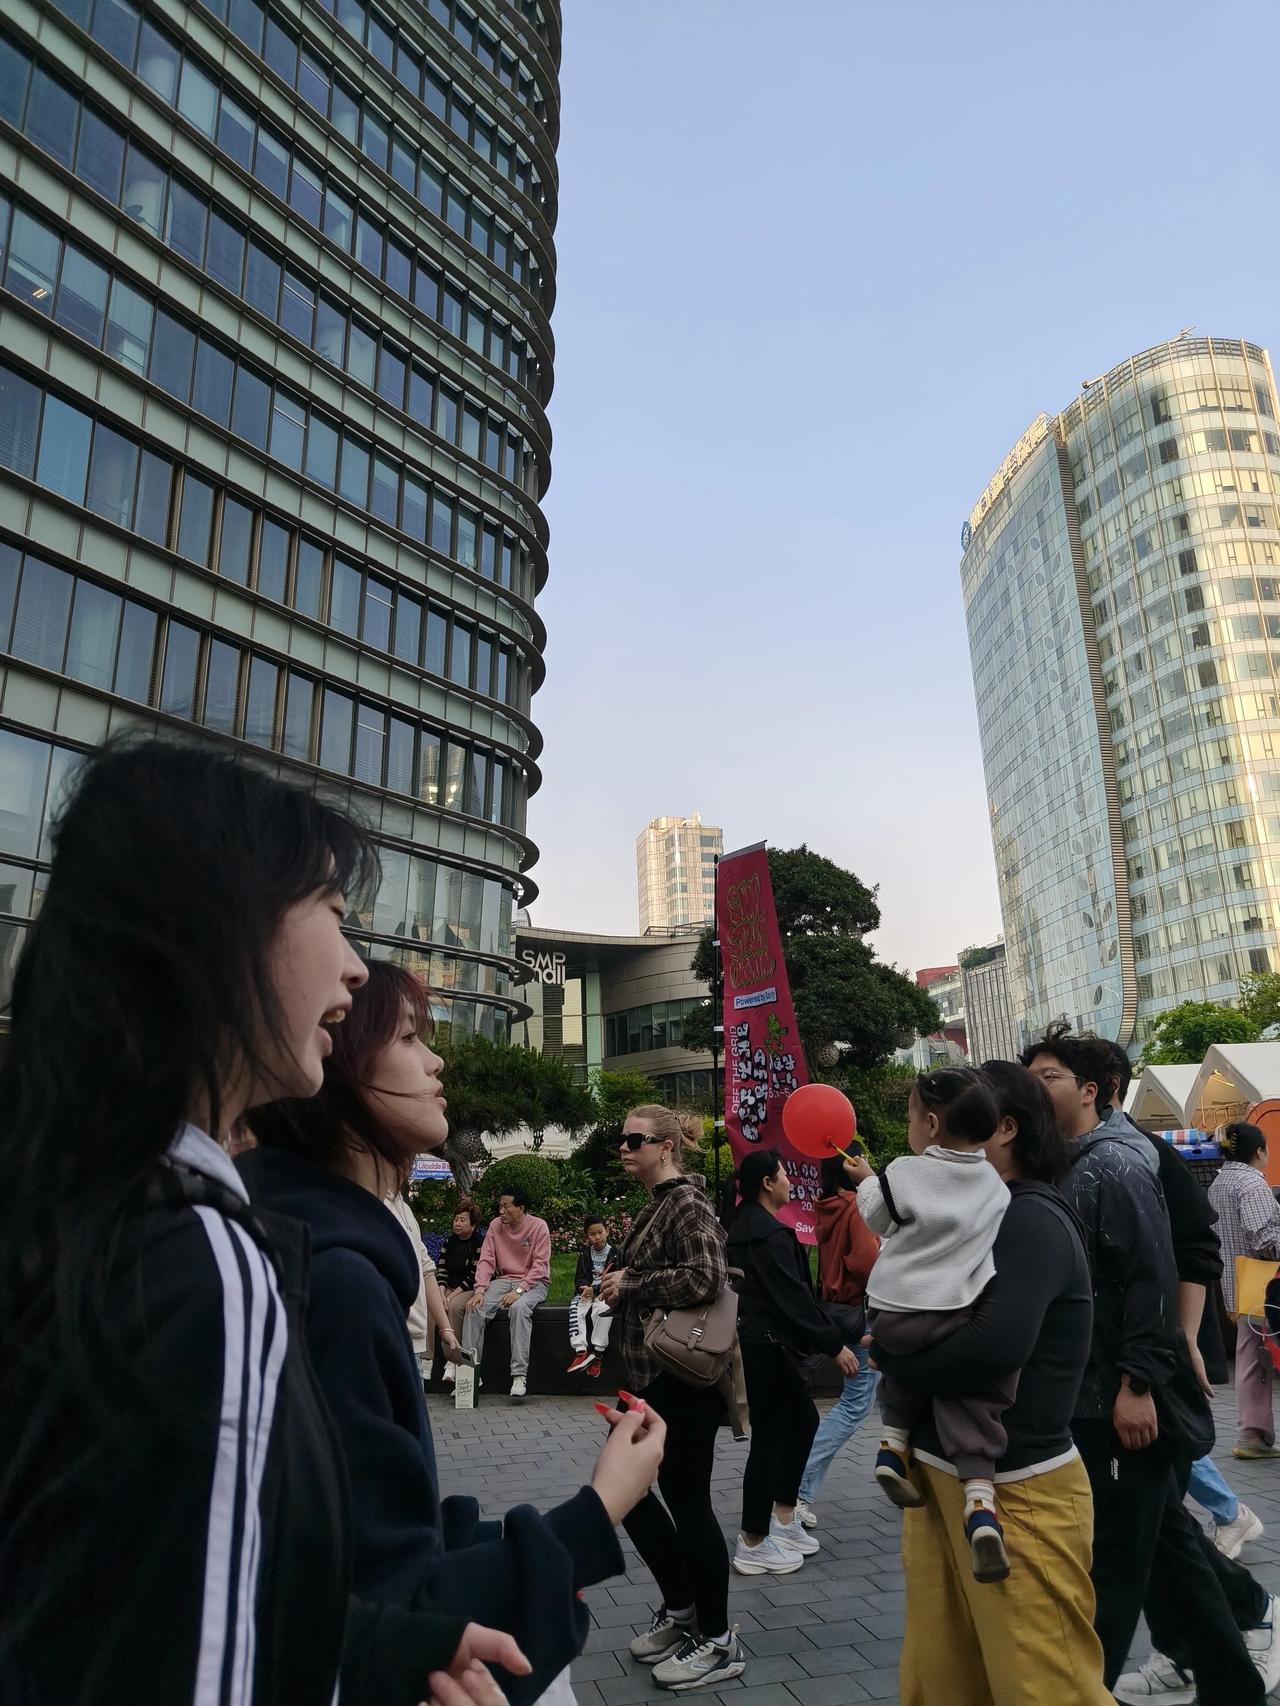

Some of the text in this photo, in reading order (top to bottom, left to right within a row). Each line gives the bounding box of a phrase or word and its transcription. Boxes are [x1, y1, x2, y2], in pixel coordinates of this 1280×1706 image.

[522, 950, 566, 969] SMP
[735, 995, 760, 1006] Powered
[730, 1026, 740, 1114] OFF THE GRID
